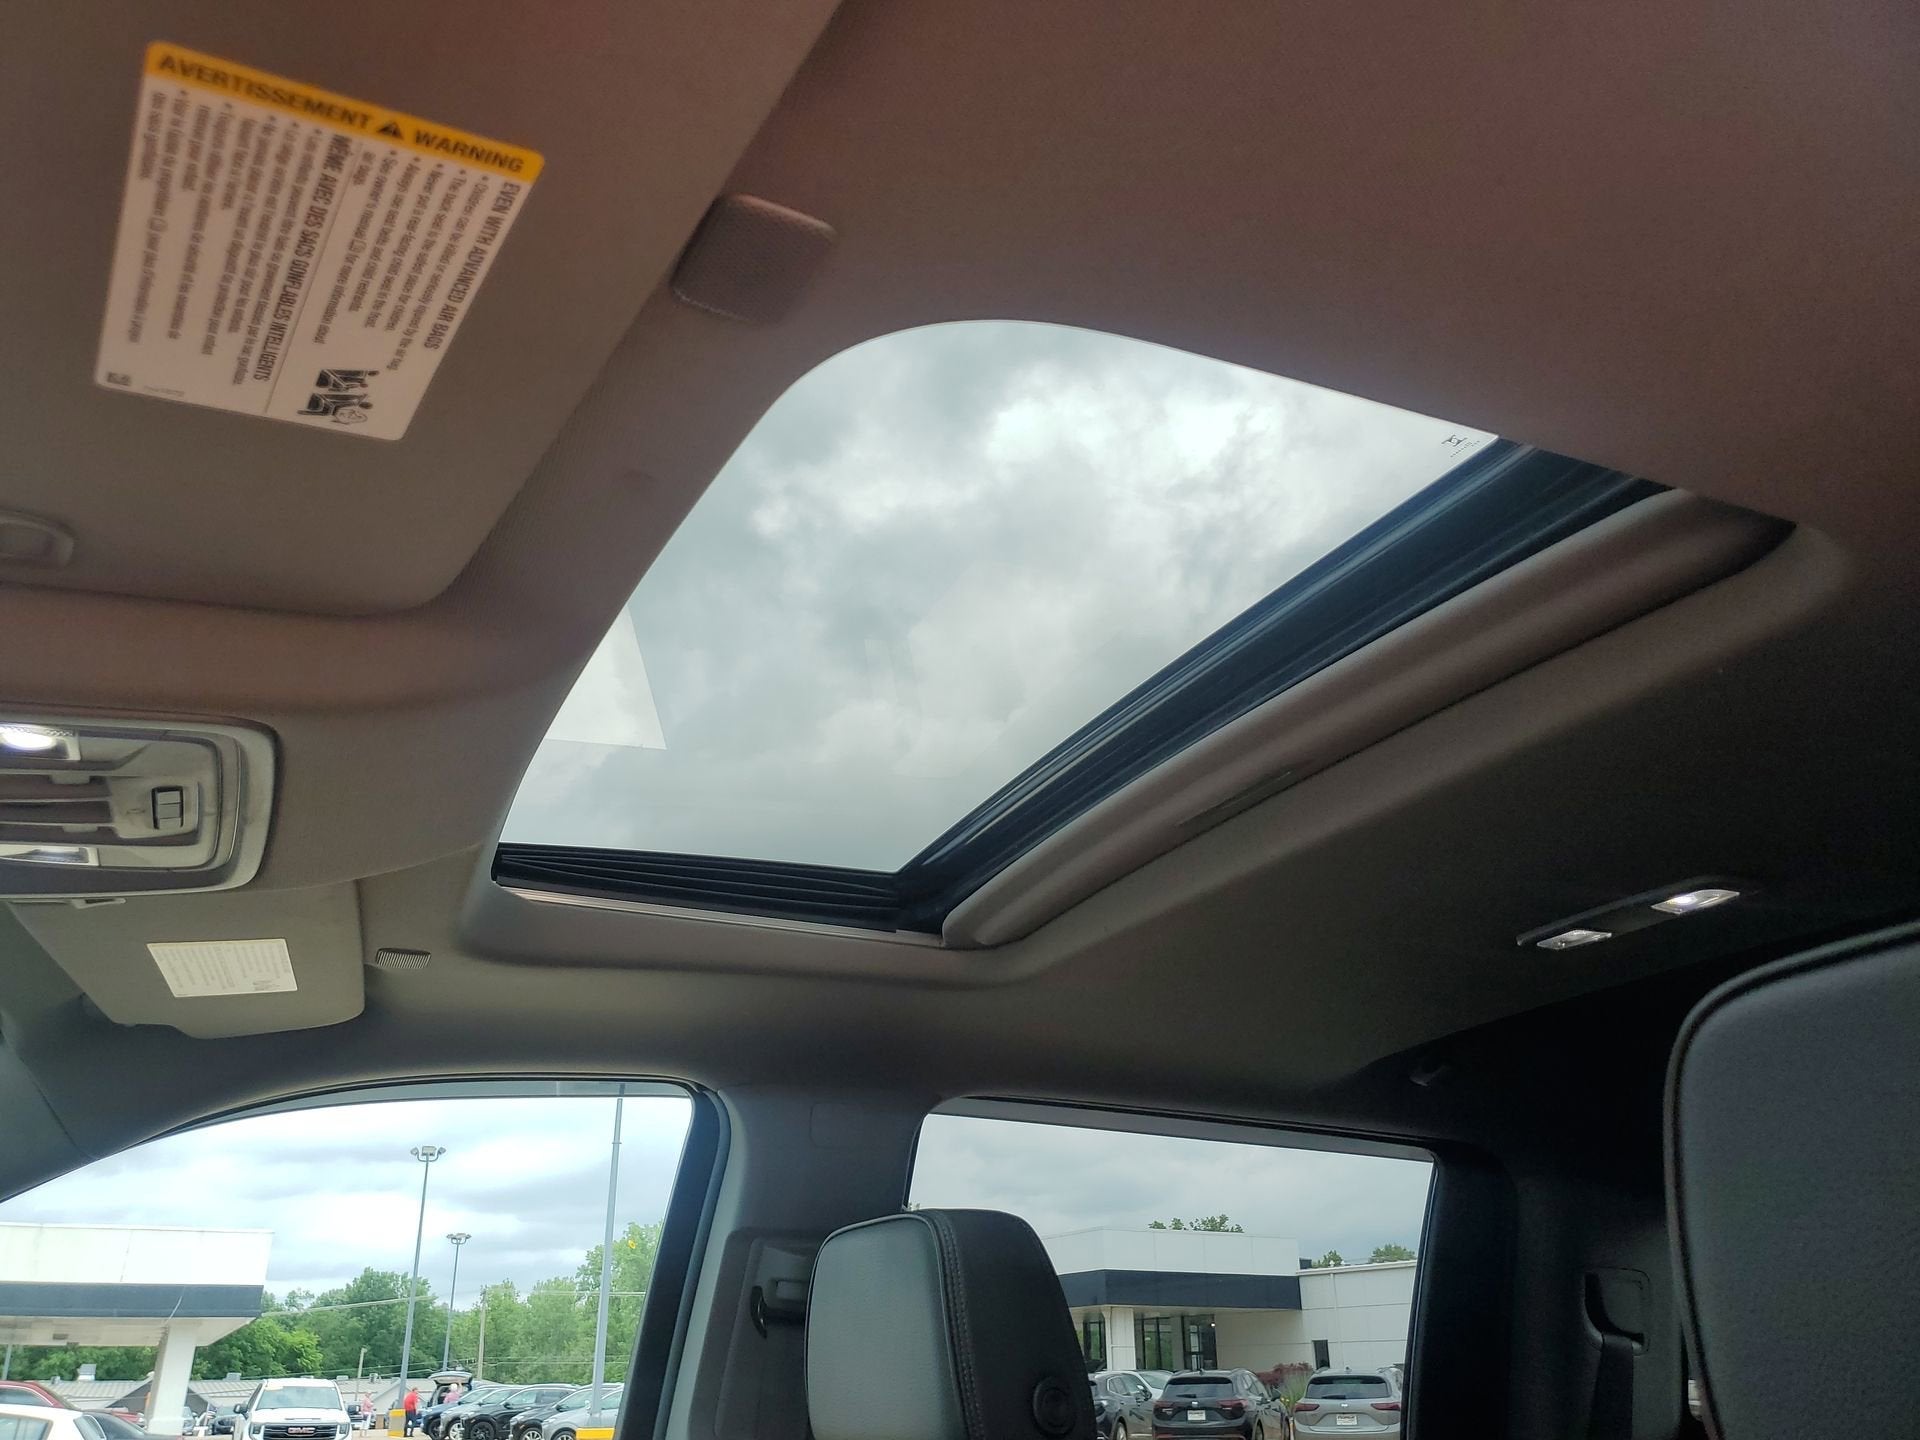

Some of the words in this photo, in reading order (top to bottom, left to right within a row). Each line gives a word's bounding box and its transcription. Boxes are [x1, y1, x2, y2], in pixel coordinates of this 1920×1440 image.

[160, 56, 371, 128] AVERTISSEMENT
[414, 130, 524, 173] WARNING
[312, 173, 338, 205] AVEC
[491, 182, 521, 214] EVEN
[304, 205, 328, 229] DES
[475, 216, 504, 246] WITH
[294, 229, 320, 258] SACS
[273, 259, 310, 321] GONFLABLES
[447, 245, 488, 303] ADVANCED
[437, 303, 458, 323] AIR
[253, 321, 288, 381] INTELLIGENTS
[423, 323, 450, 350] BAGS
